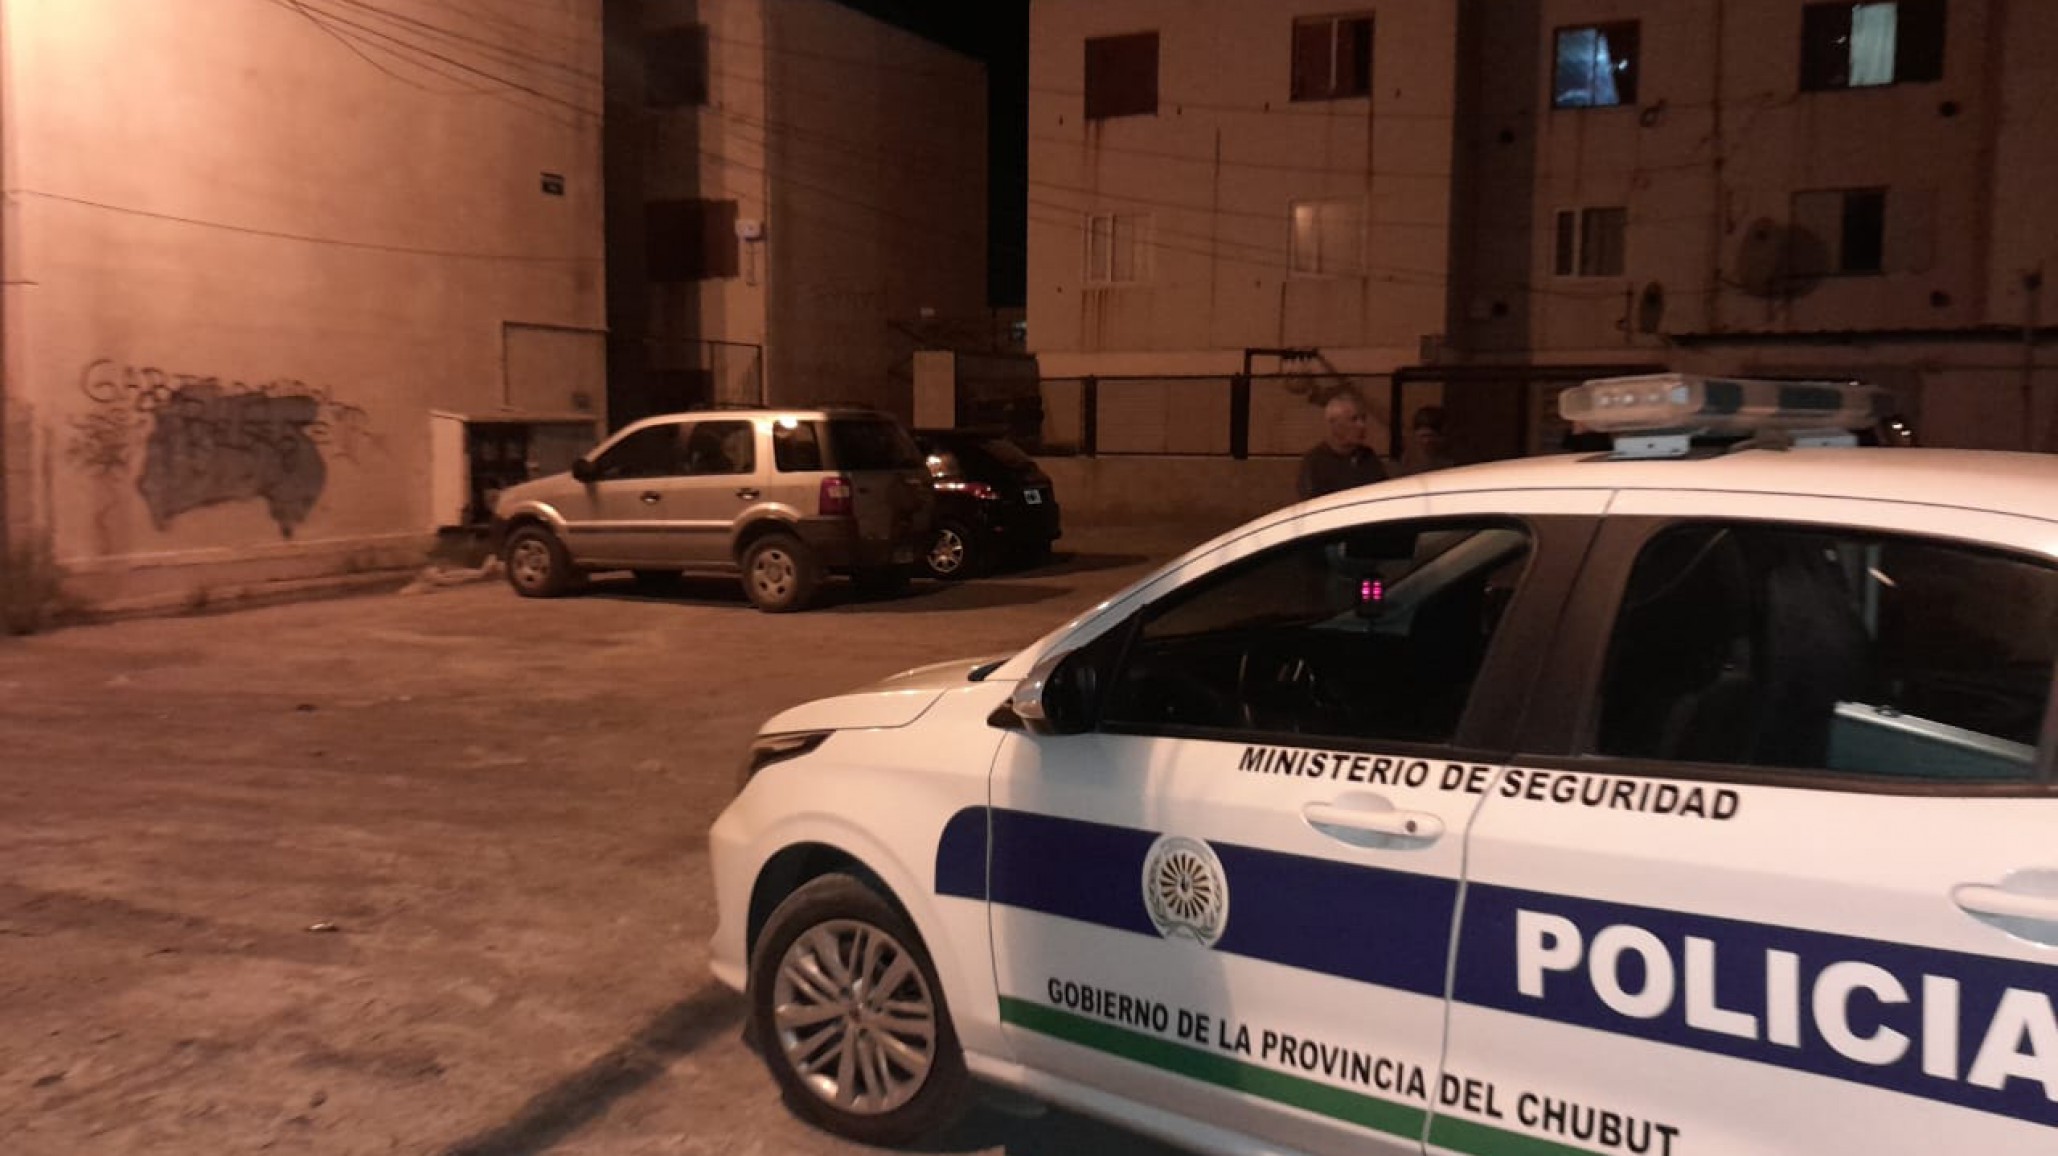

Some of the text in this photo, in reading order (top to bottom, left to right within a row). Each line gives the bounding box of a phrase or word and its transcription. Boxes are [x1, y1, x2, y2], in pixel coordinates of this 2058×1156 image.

[1238, 747, 1739, 820] MINISTERIO DE SEGURIDAD
[1047, 978, 1679, 1156] GOBIERNO DE LA PROVINCIA DEL CHUBUT
[1515, 908, 2058, 1101] POLICIA
